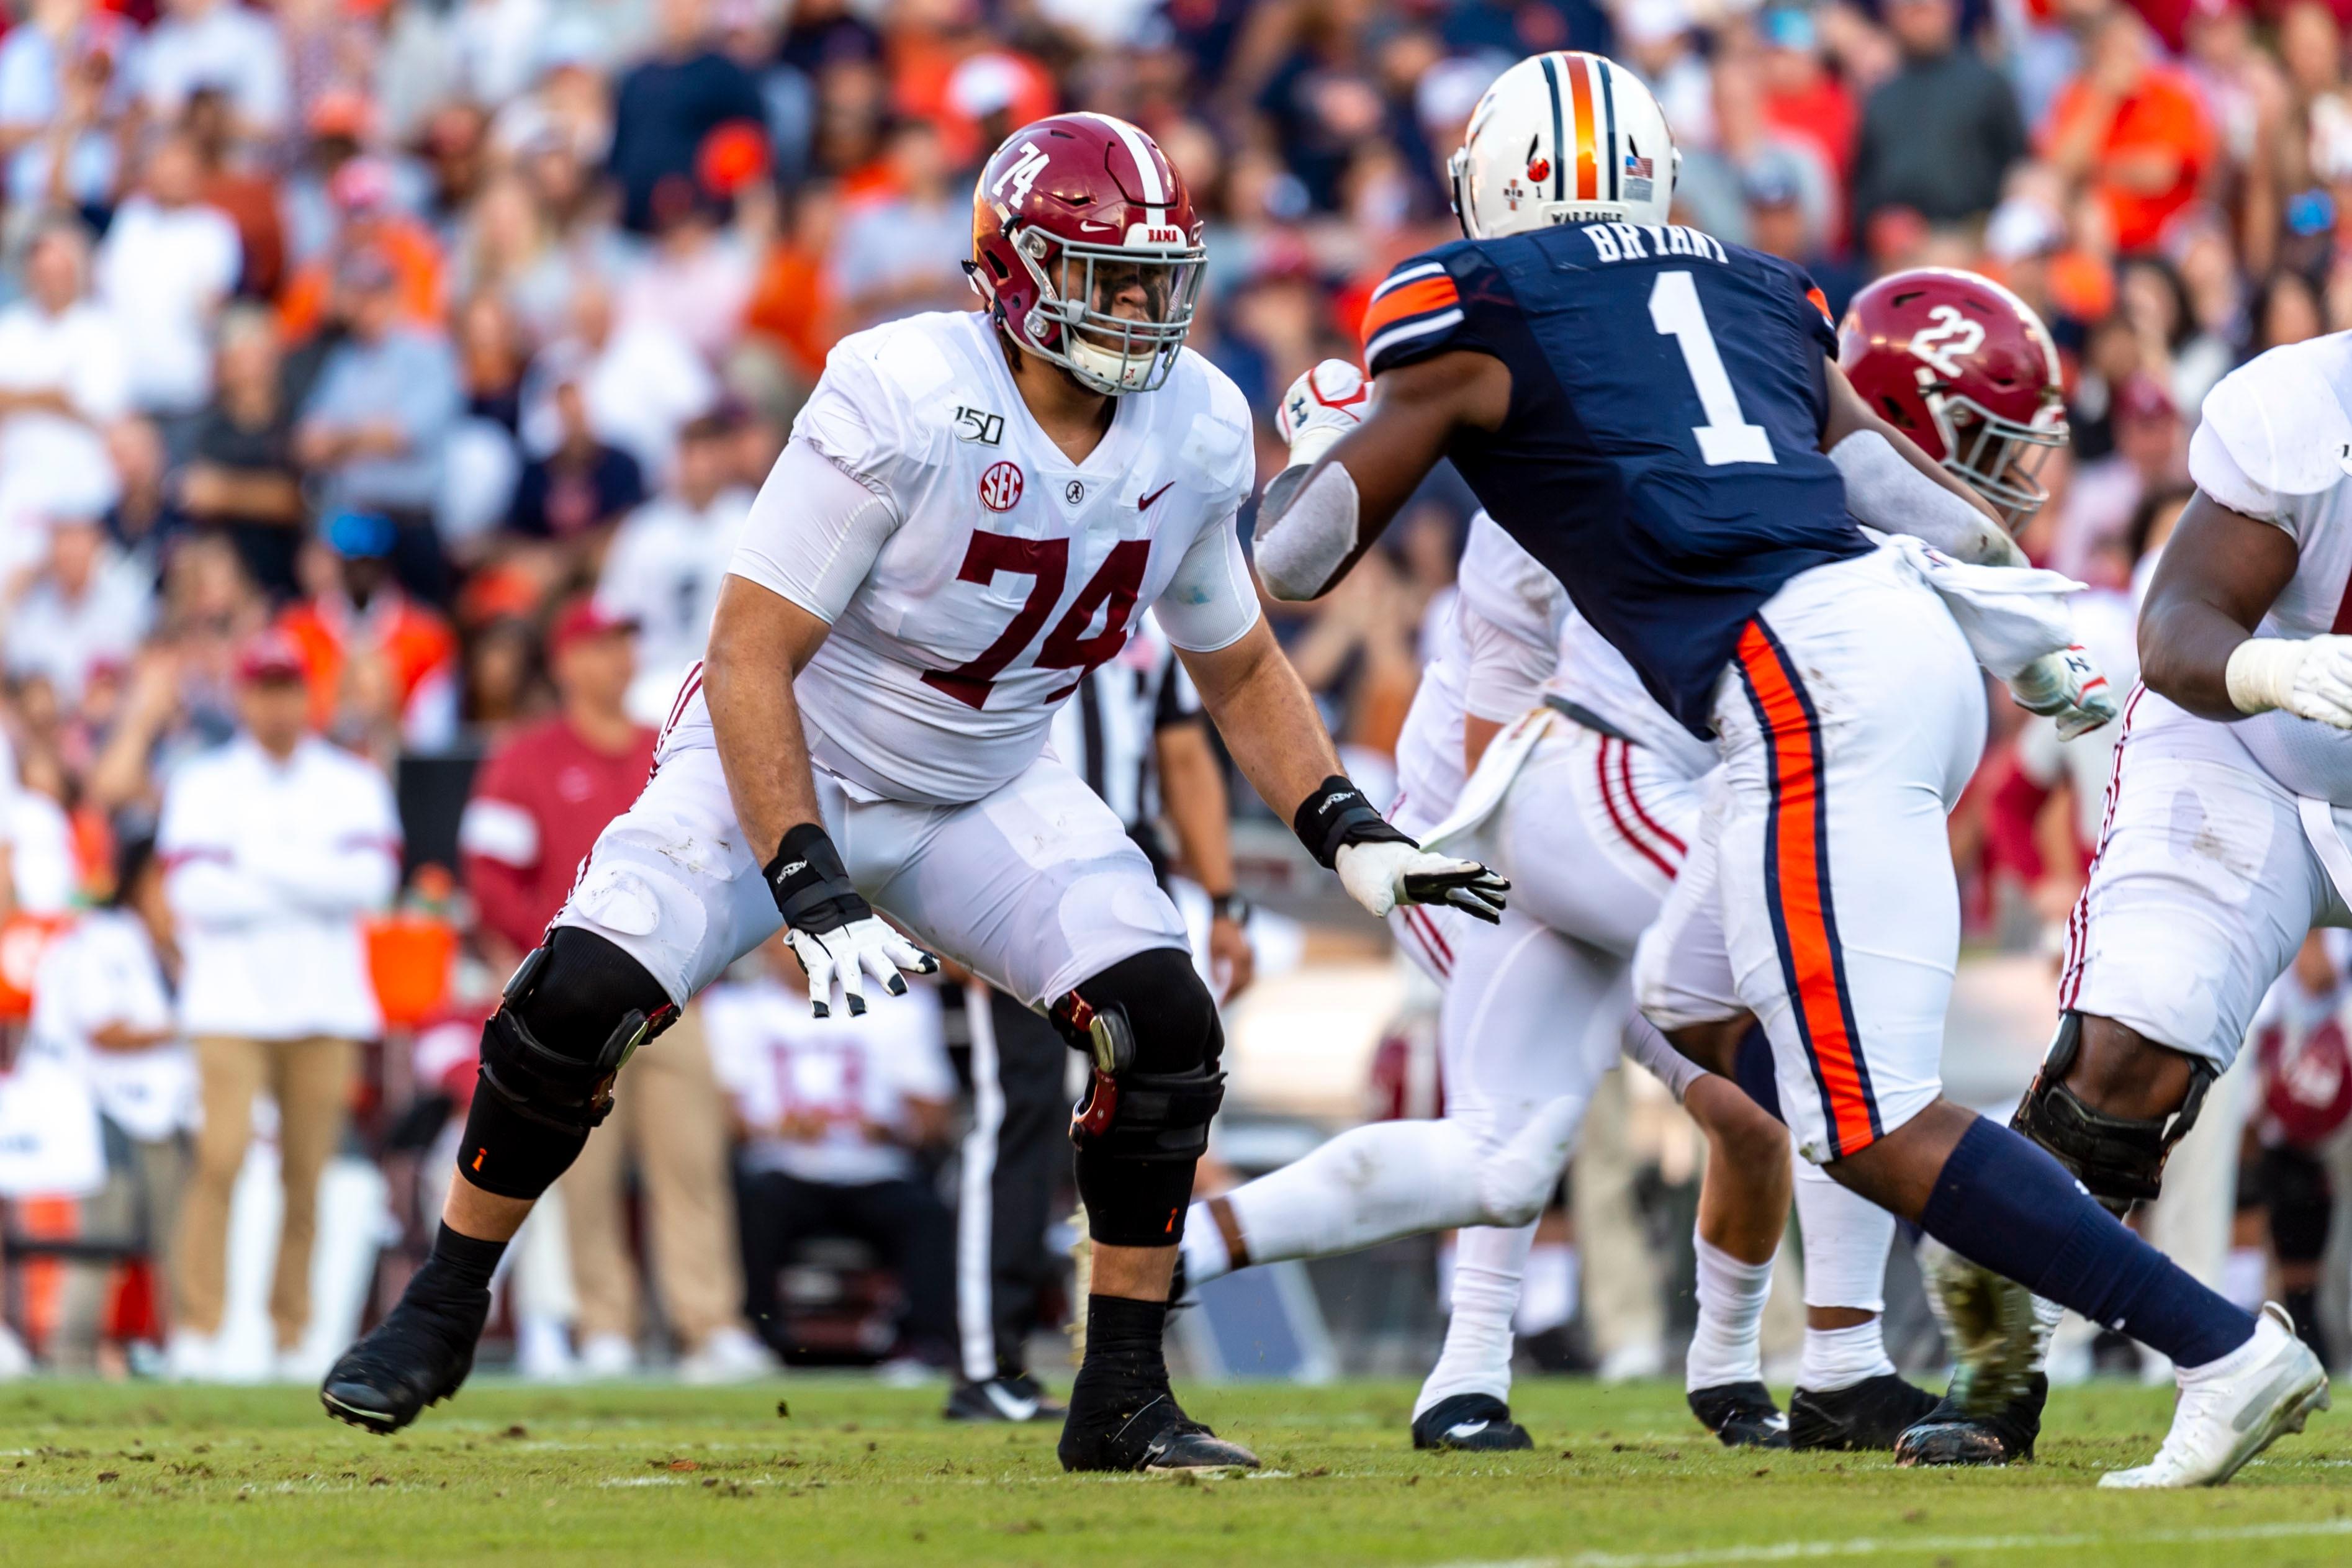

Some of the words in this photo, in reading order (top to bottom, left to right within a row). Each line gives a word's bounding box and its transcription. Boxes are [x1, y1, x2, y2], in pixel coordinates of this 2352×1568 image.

[991, 141, 1050, 210] 74
[1536, 186, 1542, 199] 1
[1148, 229, 1178, 243] BAMA
[1552, 212, 1579, 223] WAR
[1580, 222, 1729, 264] BRYANT
[1908, 305, 1985, 378] 22
[1647, 270, 1778, 466] 1
[955, 406, 1004, 446] 150
[983, 463, 1022, 508] SEC
[919, 528, 1151, 711] 74
